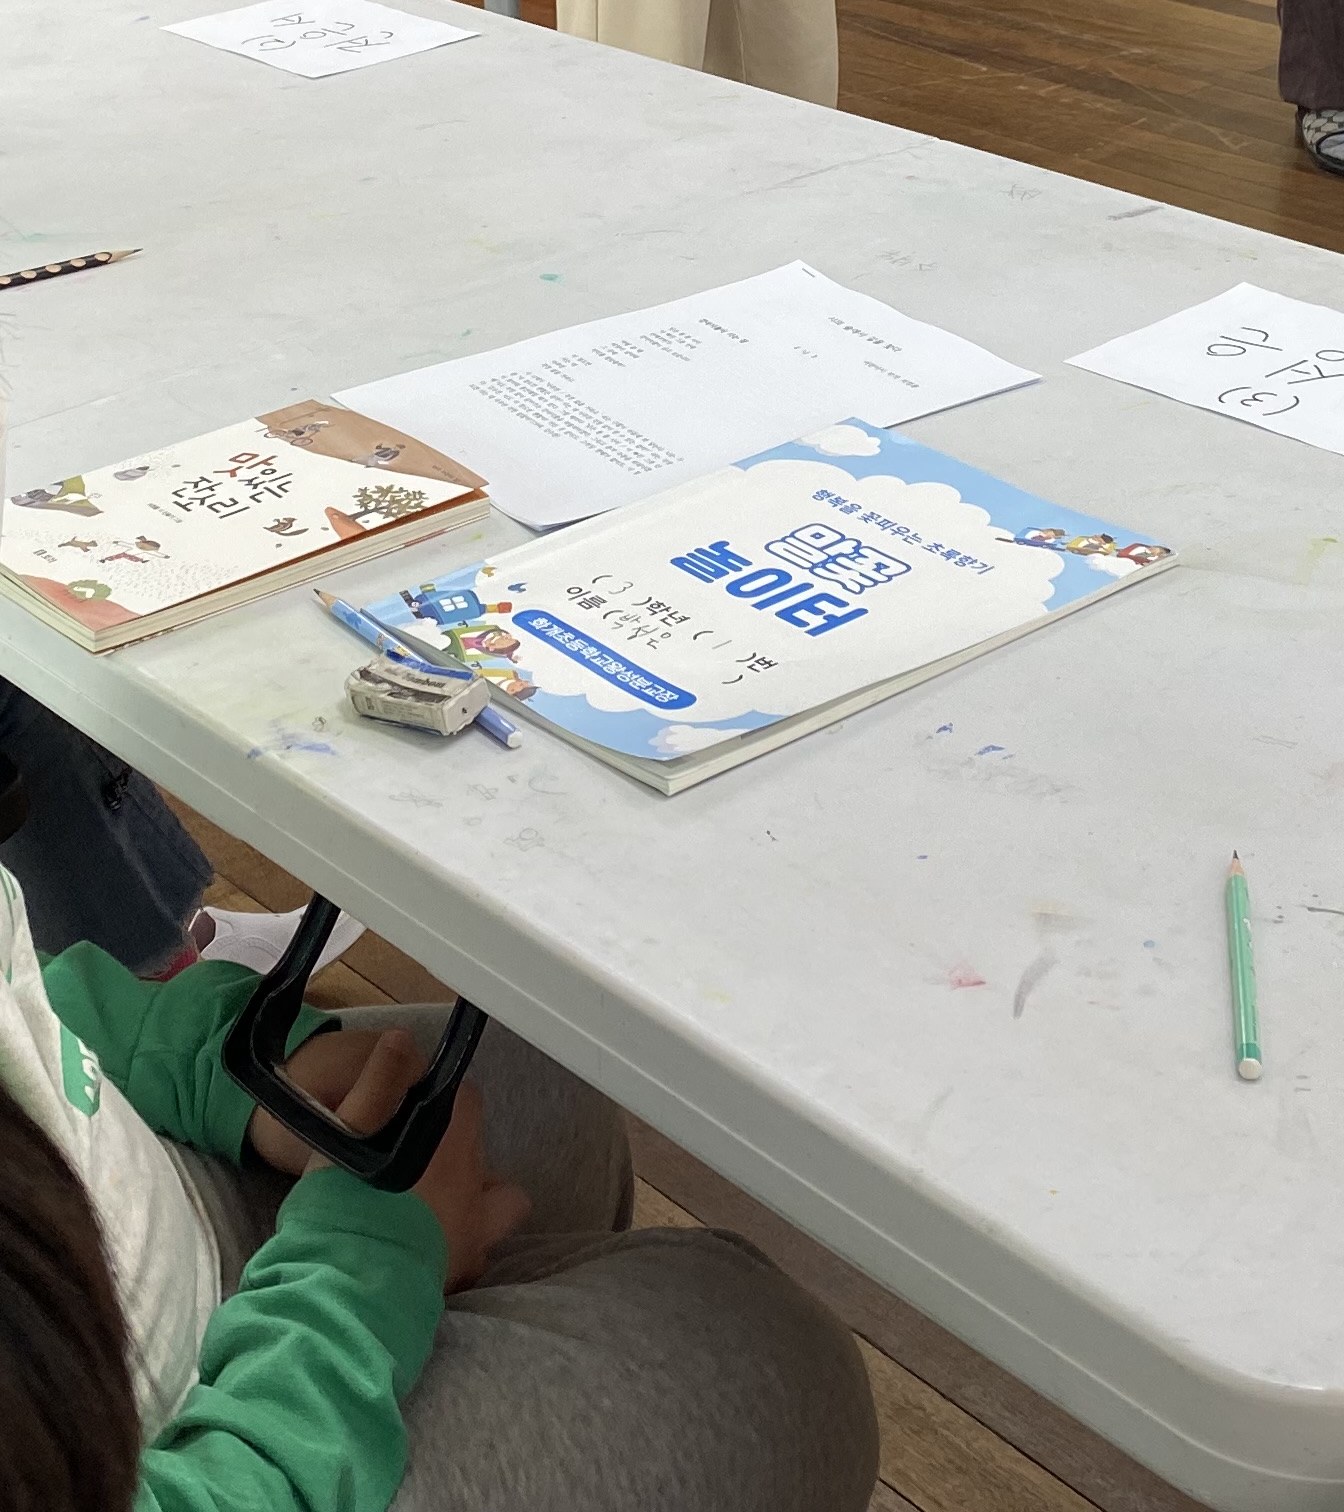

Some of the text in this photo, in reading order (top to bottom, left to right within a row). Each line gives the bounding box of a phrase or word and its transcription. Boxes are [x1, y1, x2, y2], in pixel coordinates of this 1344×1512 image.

[172, 477, 250, 519] 잔소리
[213, 453, 292, 503] 맛있는
[764, 523, 912, 595] 말꽃
[812, 490, 994, 574] 행복을 꽃피우는 초록향기
[567, 587, 607, 610] 이름
[670, 541, 868, 636] 놀이터
[527, 616, 681, 705] 화개초등학교왕성분교장
